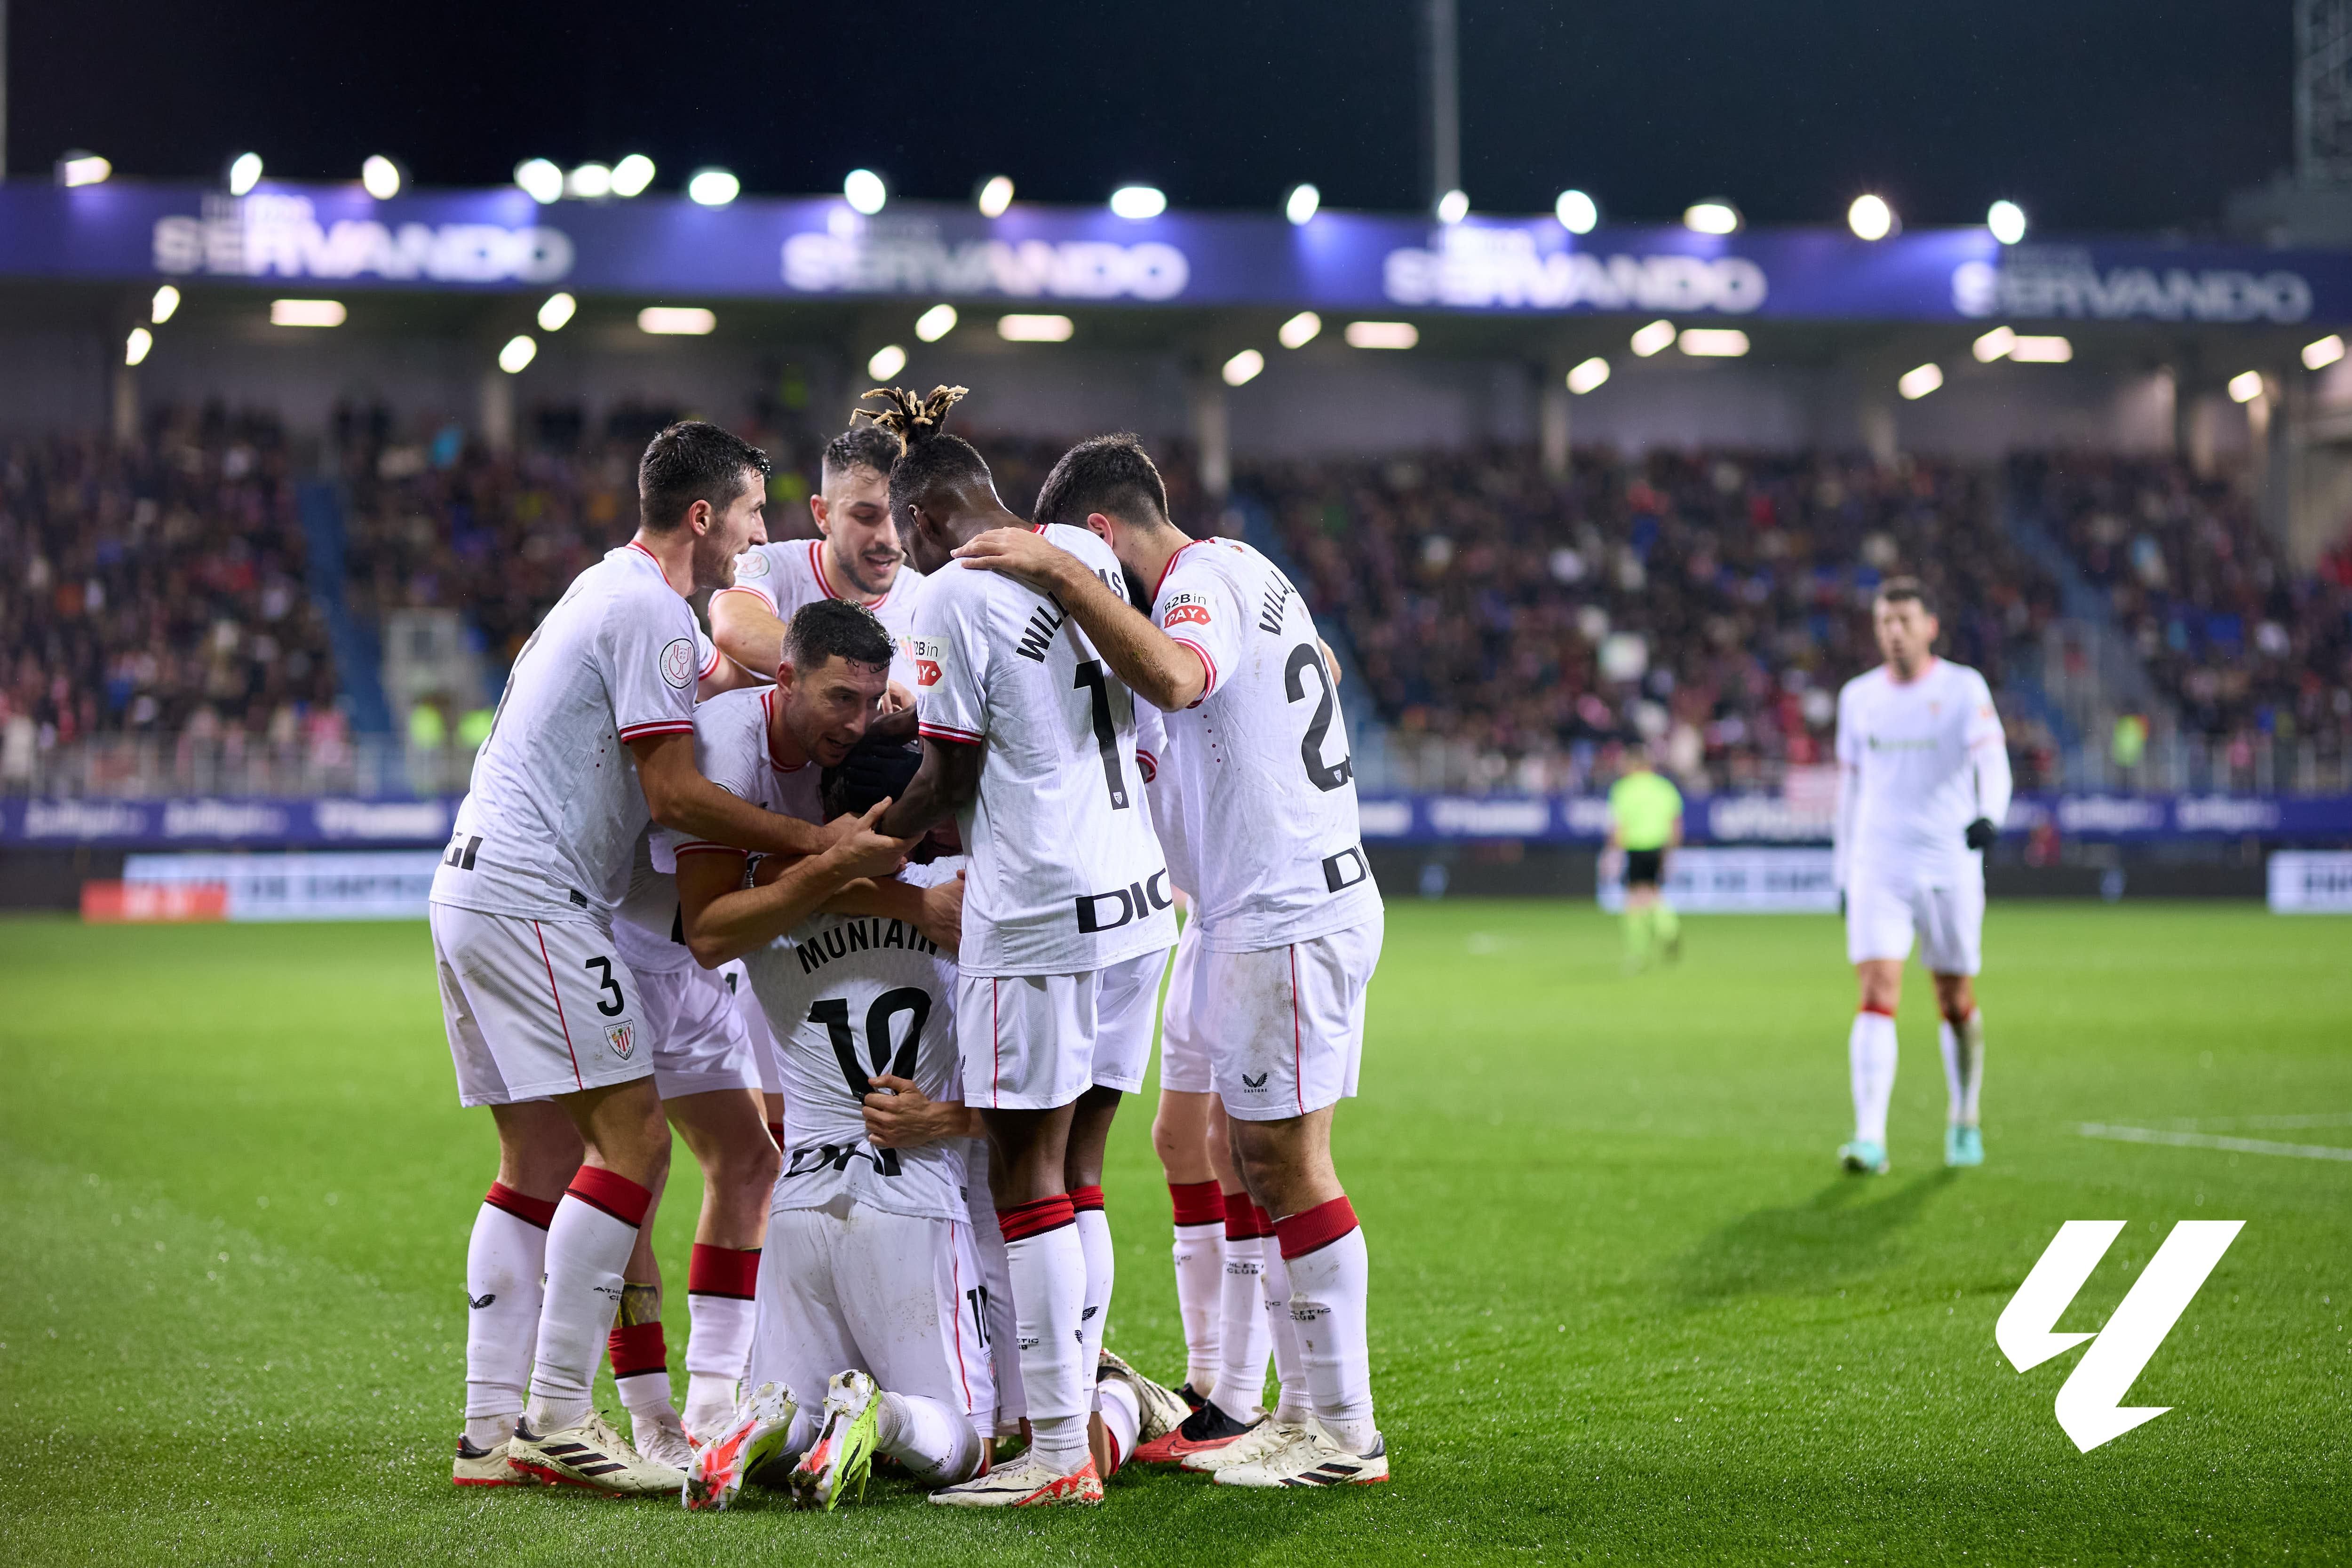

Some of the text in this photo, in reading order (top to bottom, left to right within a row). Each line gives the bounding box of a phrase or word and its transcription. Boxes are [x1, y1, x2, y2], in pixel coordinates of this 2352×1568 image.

[153, 216, 574, 282] SERVANDO
[1951, 261, 2312, 324] SERVANDO
[1167, 608, 1199, 626] PAY
[1285, 643, 1353, 792] 2
[585, 955, 625, 1017] 3
[807, 987, 932, 1105] 10
